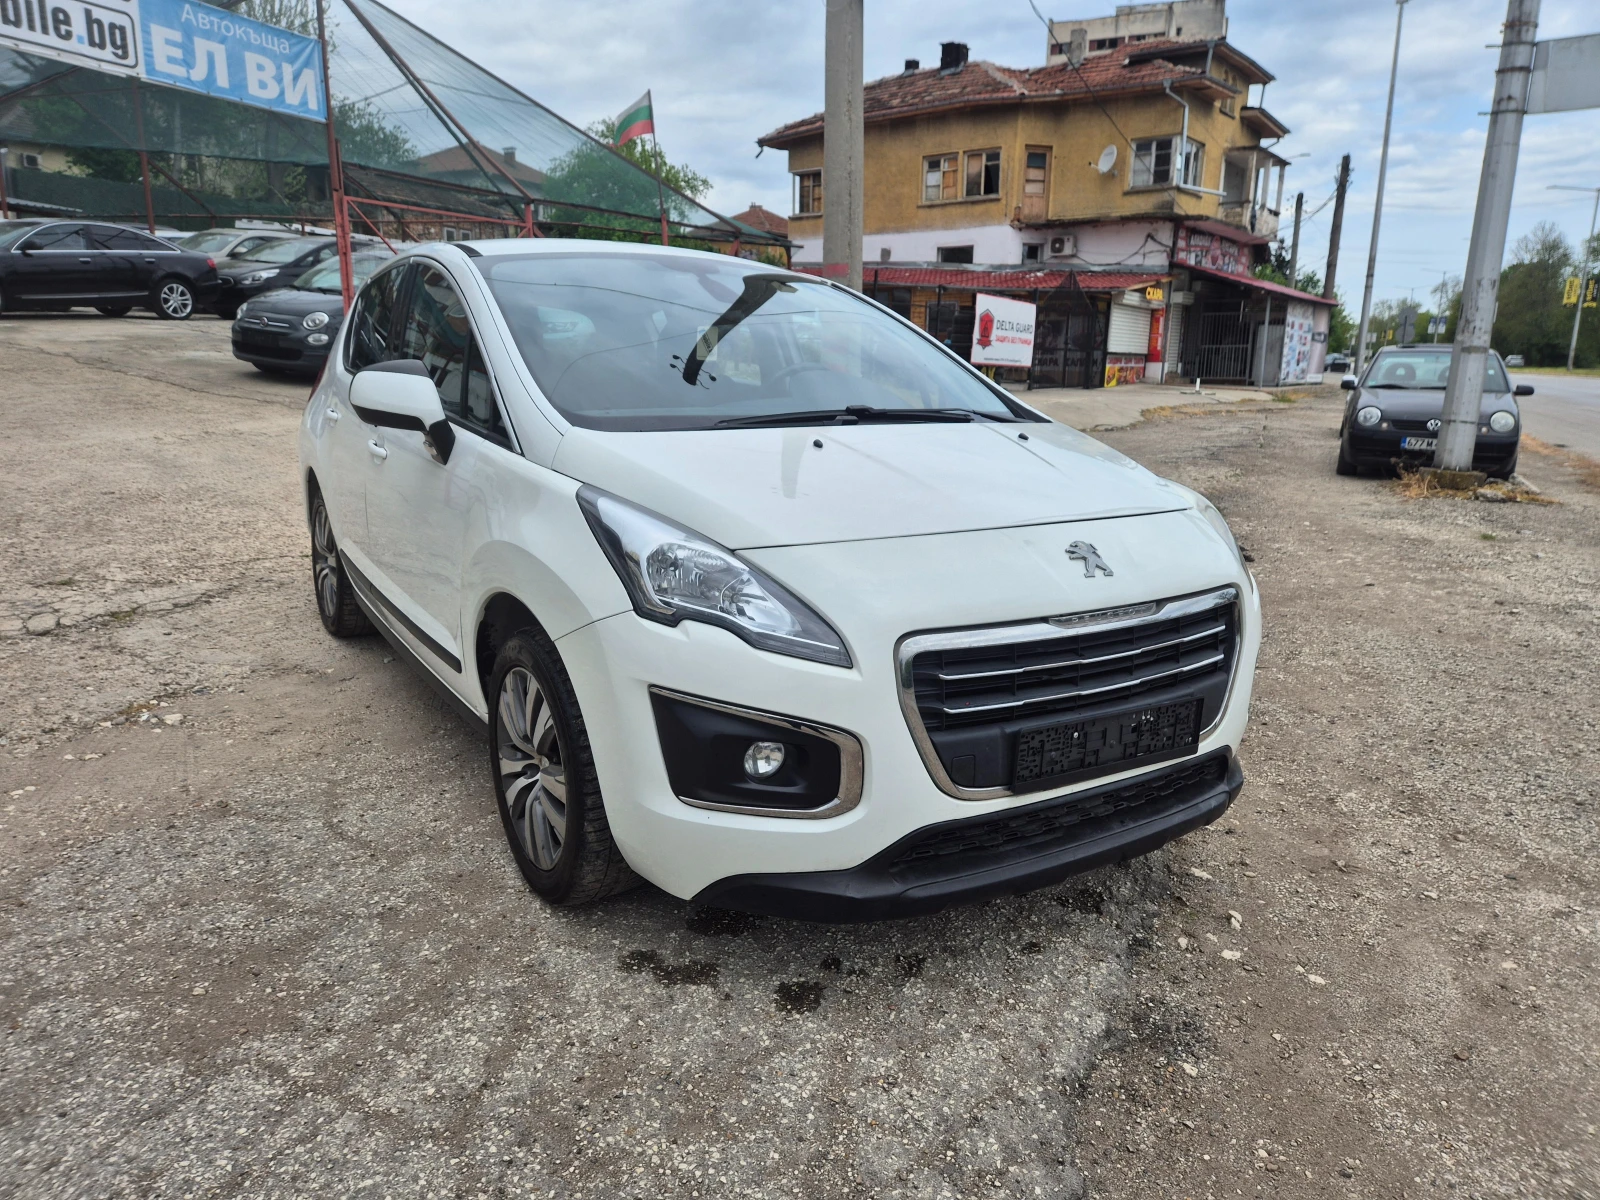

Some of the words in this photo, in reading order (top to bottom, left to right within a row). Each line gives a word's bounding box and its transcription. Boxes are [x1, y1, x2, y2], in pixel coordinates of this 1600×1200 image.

[181, 4, 290, 54] Автокъща
[150, 23, 230, 89] ЕЛ
[244, 51, 318, 110] ВИ
[996, 319, 1014, 332] DELTA
[1015, 322, 1033, 334] GUARD
